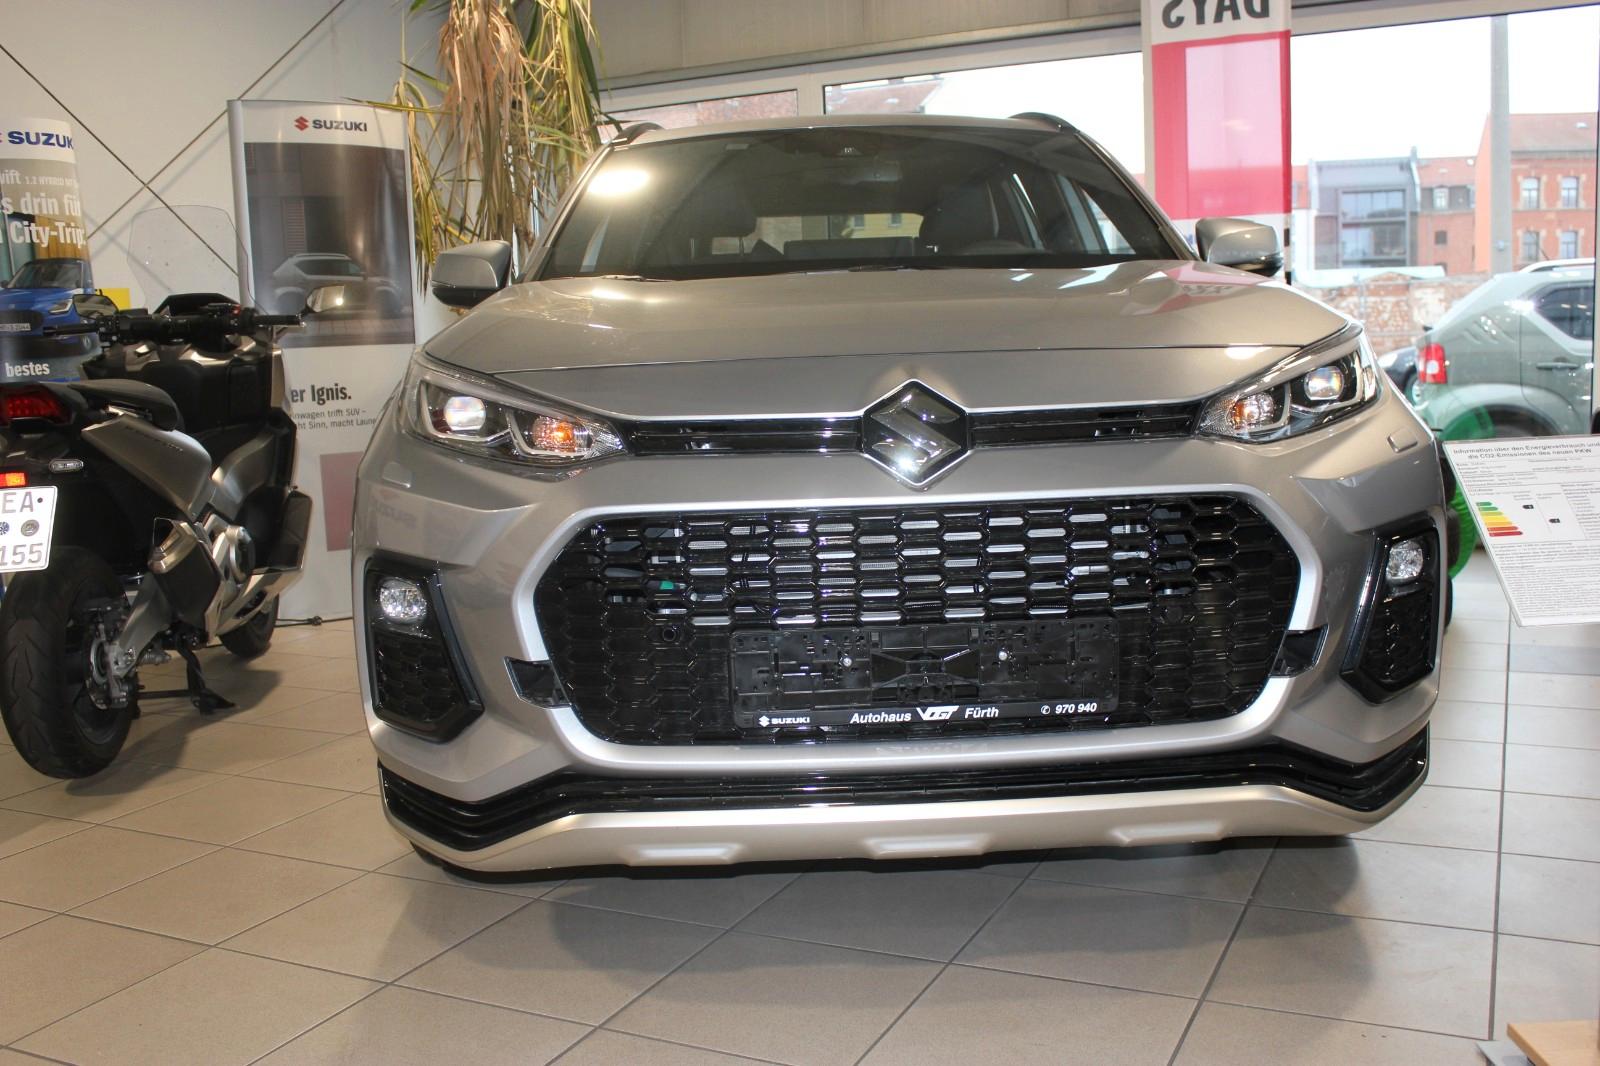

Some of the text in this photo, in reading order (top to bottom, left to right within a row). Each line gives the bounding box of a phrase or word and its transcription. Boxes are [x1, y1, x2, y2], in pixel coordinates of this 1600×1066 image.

[312, 119, 368, 132] SUZUKI
[20, 192, 60, 215] drin
[4, 361, 50, 377] bestes
[310, 382, 352, 406] Ignis.
[345, 407, 360, 416] SUV
[308, 420, 328, 430] Sinn,
[330, 418, 354, 428] macht
[1, 491, 34, 514] EA
[0, 543, 43, 566] 155
[850, 705, 999, 724] Autohaus VOGT Fürth
[1055, 702, 1098, 714] 970 940
[771, 717, 811, 725] SUZUKI
